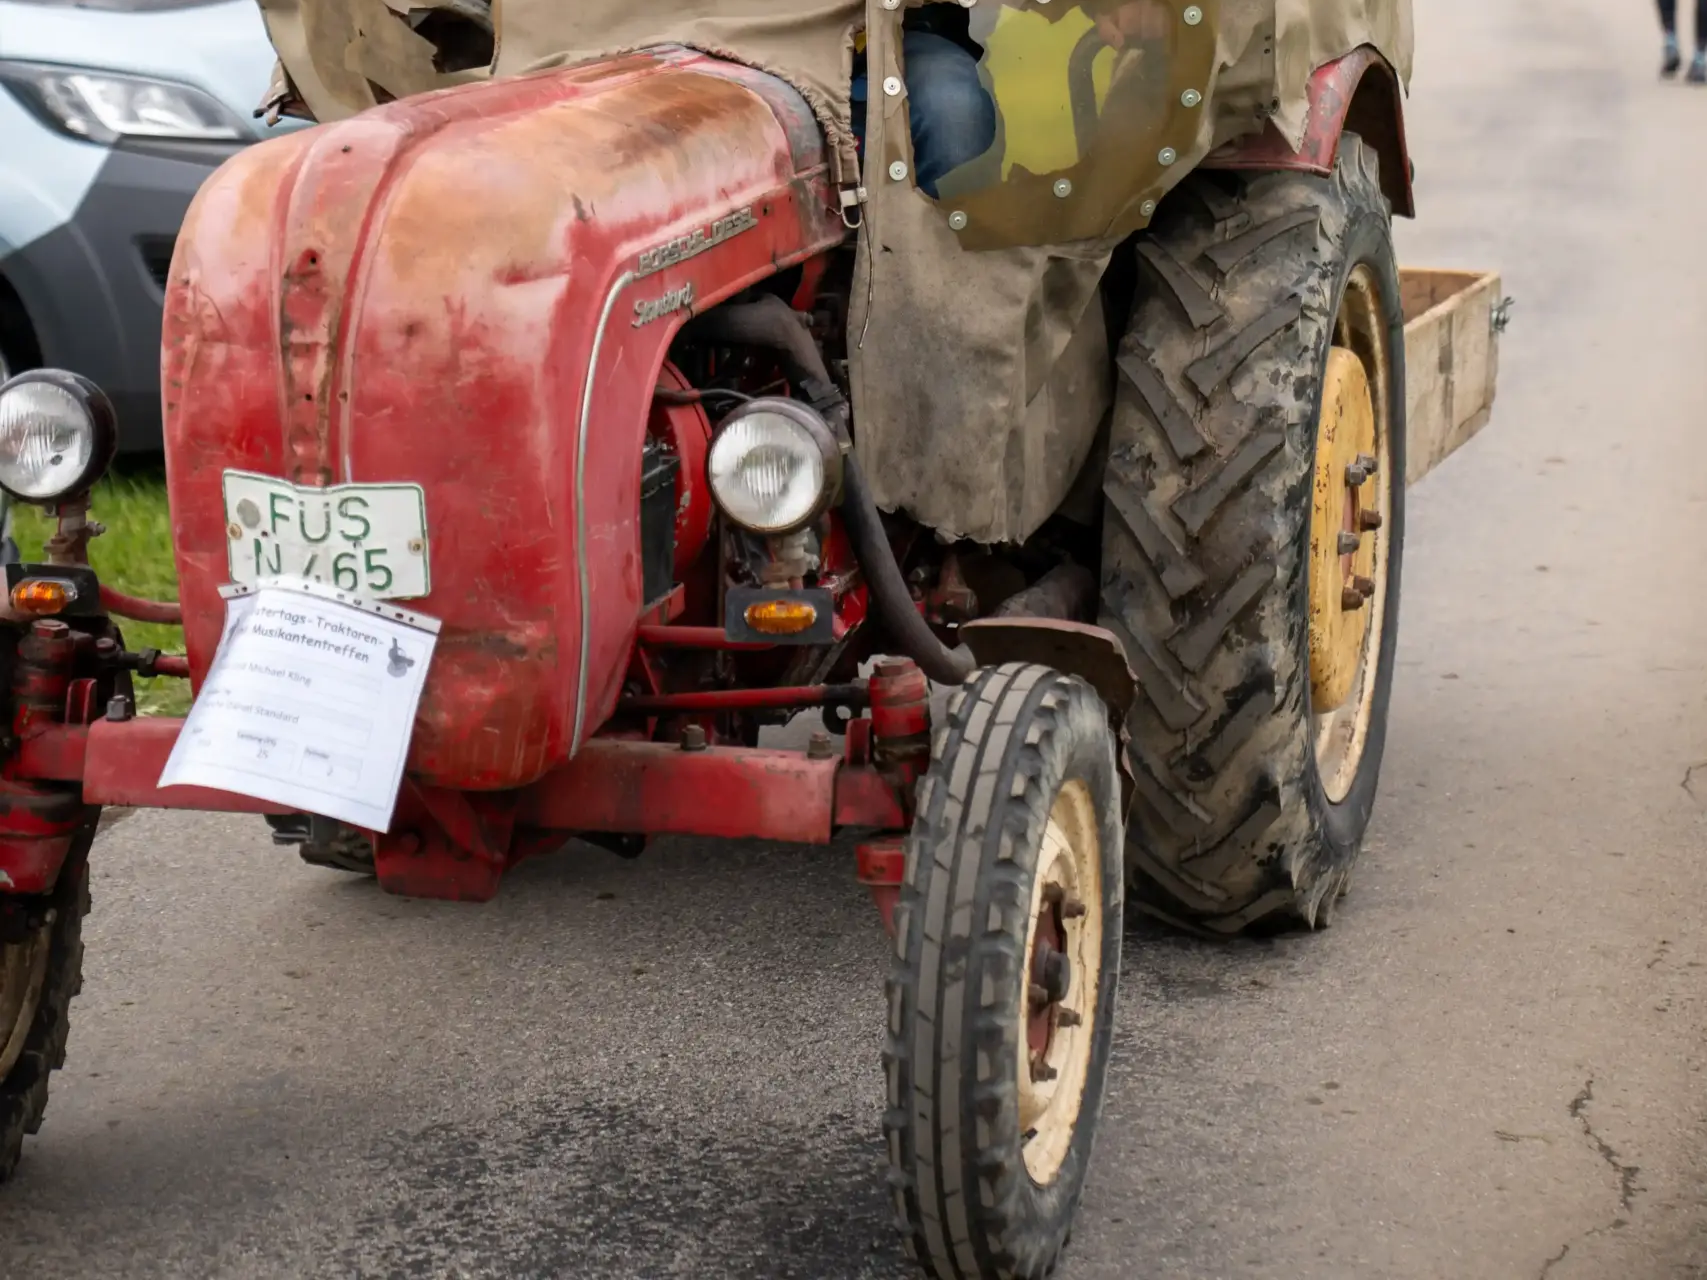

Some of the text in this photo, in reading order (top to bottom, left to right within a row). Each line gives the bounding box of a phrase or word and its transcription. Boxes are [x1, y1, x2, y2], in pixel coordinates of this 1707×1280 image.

[269, 492, 371, 544] FÜS
[253, 538, 282, 576] N
[251, 623, 370, 663] Musikantentreffen
[248, 662, 286, 677] Michael
[255, 705, 300, 724] Standard
